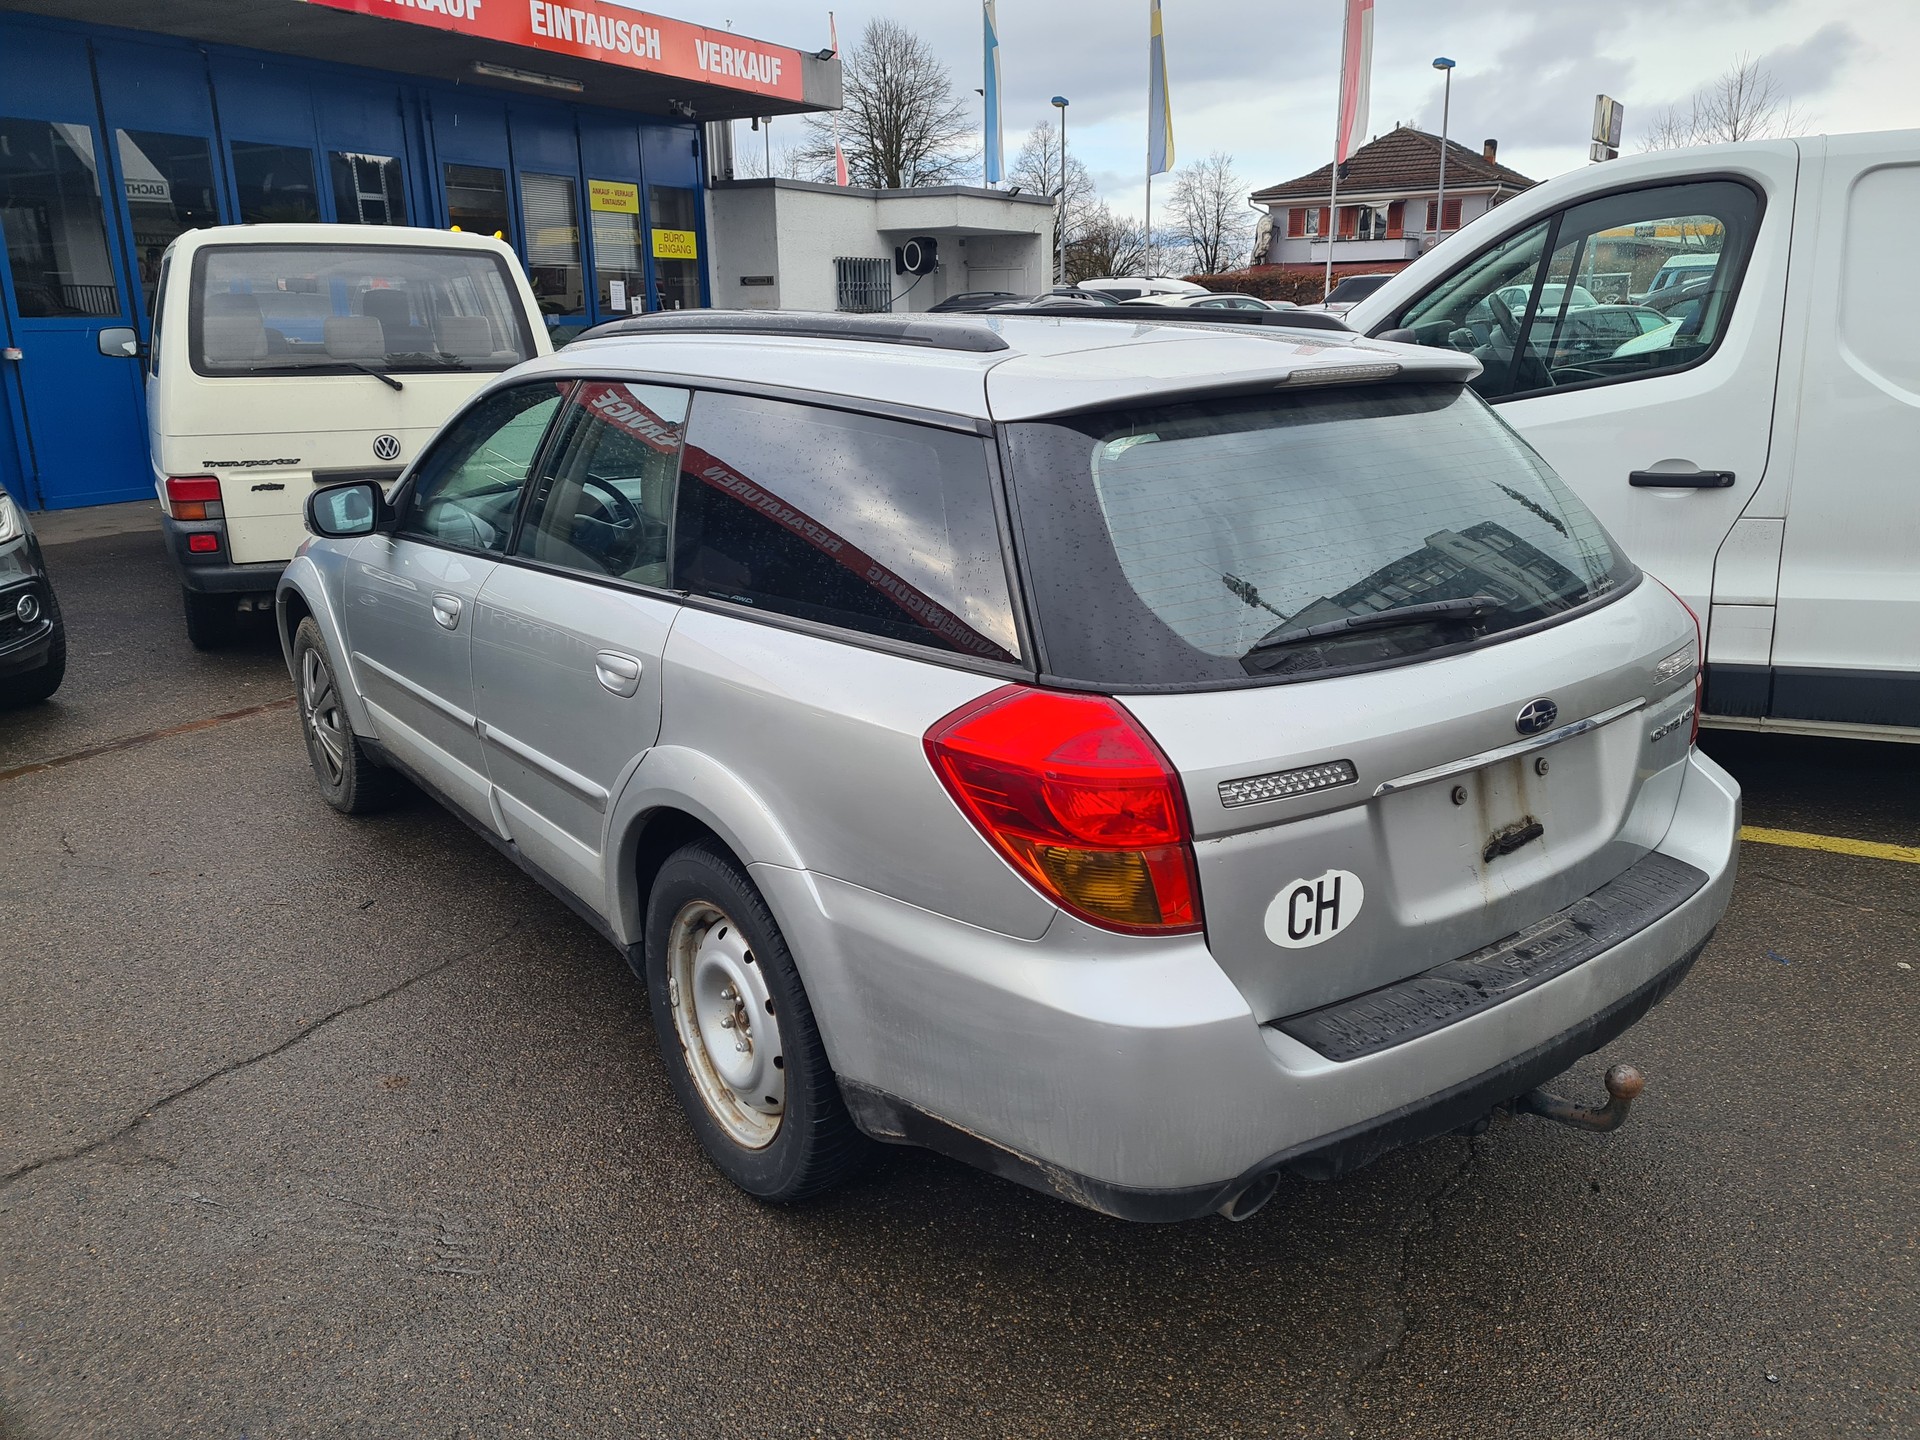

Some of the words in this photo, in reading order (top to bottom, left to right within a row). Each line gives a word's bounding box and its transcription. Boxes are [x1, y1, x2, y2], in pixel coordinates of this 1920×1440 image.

[530, 0, 661, 60] EINTAUSCH
[695, 38, 782, 86] VERKAUF
[592, 187, 610, 196] ANKAUF
[614, 189, 635, 198] VERKAUF
[602, 198, 627, 207] EINTAUSCH
[663, 232, 685, 244] BÜRO
[658, 243, 692, 255] EINGANG
[202, 458, 301, 468] Transporter
[730, 594, 753, 604] AWD
[1287, 876, 1342, 941] CH
